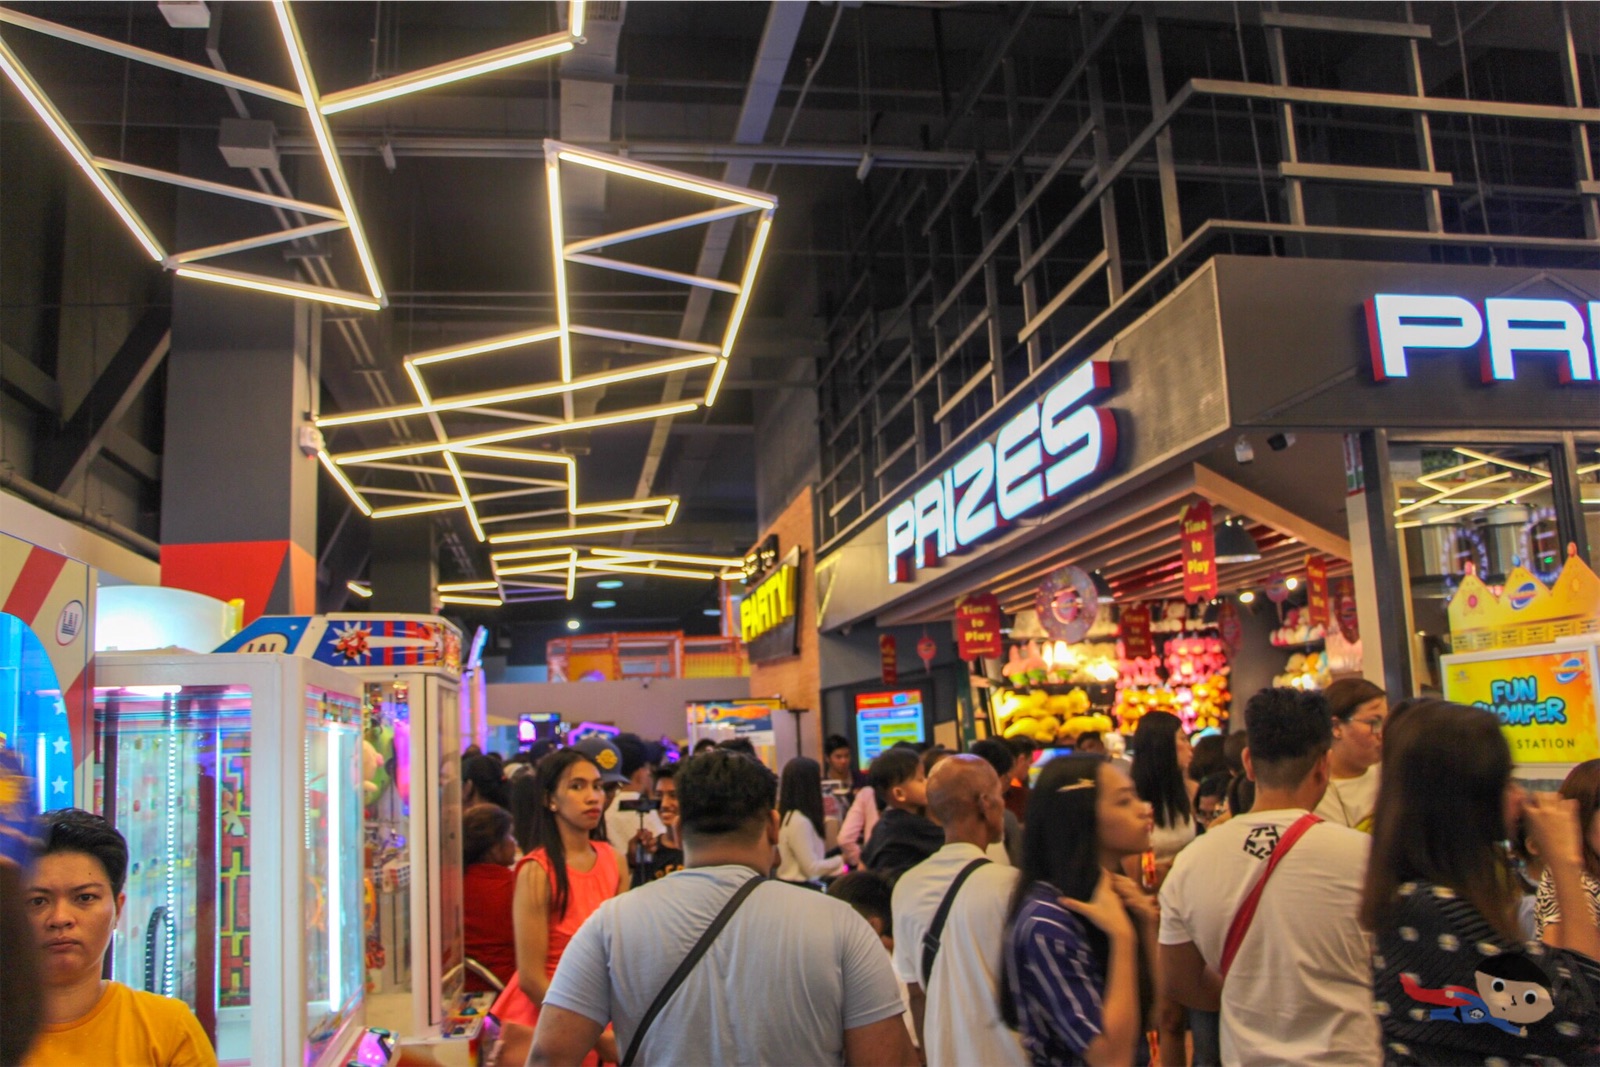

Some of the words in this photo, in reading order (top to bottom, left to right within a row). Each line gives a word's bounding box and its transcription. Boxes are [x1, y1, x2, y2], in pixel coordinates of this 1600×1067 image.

[886, 360, 1110, 584] PRIZES
[1184, 520, 1207, 534] Time
[1191, 540, 1203, 553] to
[1187, 560, 1209, 575] Play
[740, 563, 790, 643] PARTY
[962, 604, 991, 615] Time
[971, 619, 985, 628] to
[964, 630, 993, 643] Play
[1491, 675, 1537, 703] FUN
[1472, 697, 1567, 727] OMPER
[1515, 738, 1575, 750] STATION
